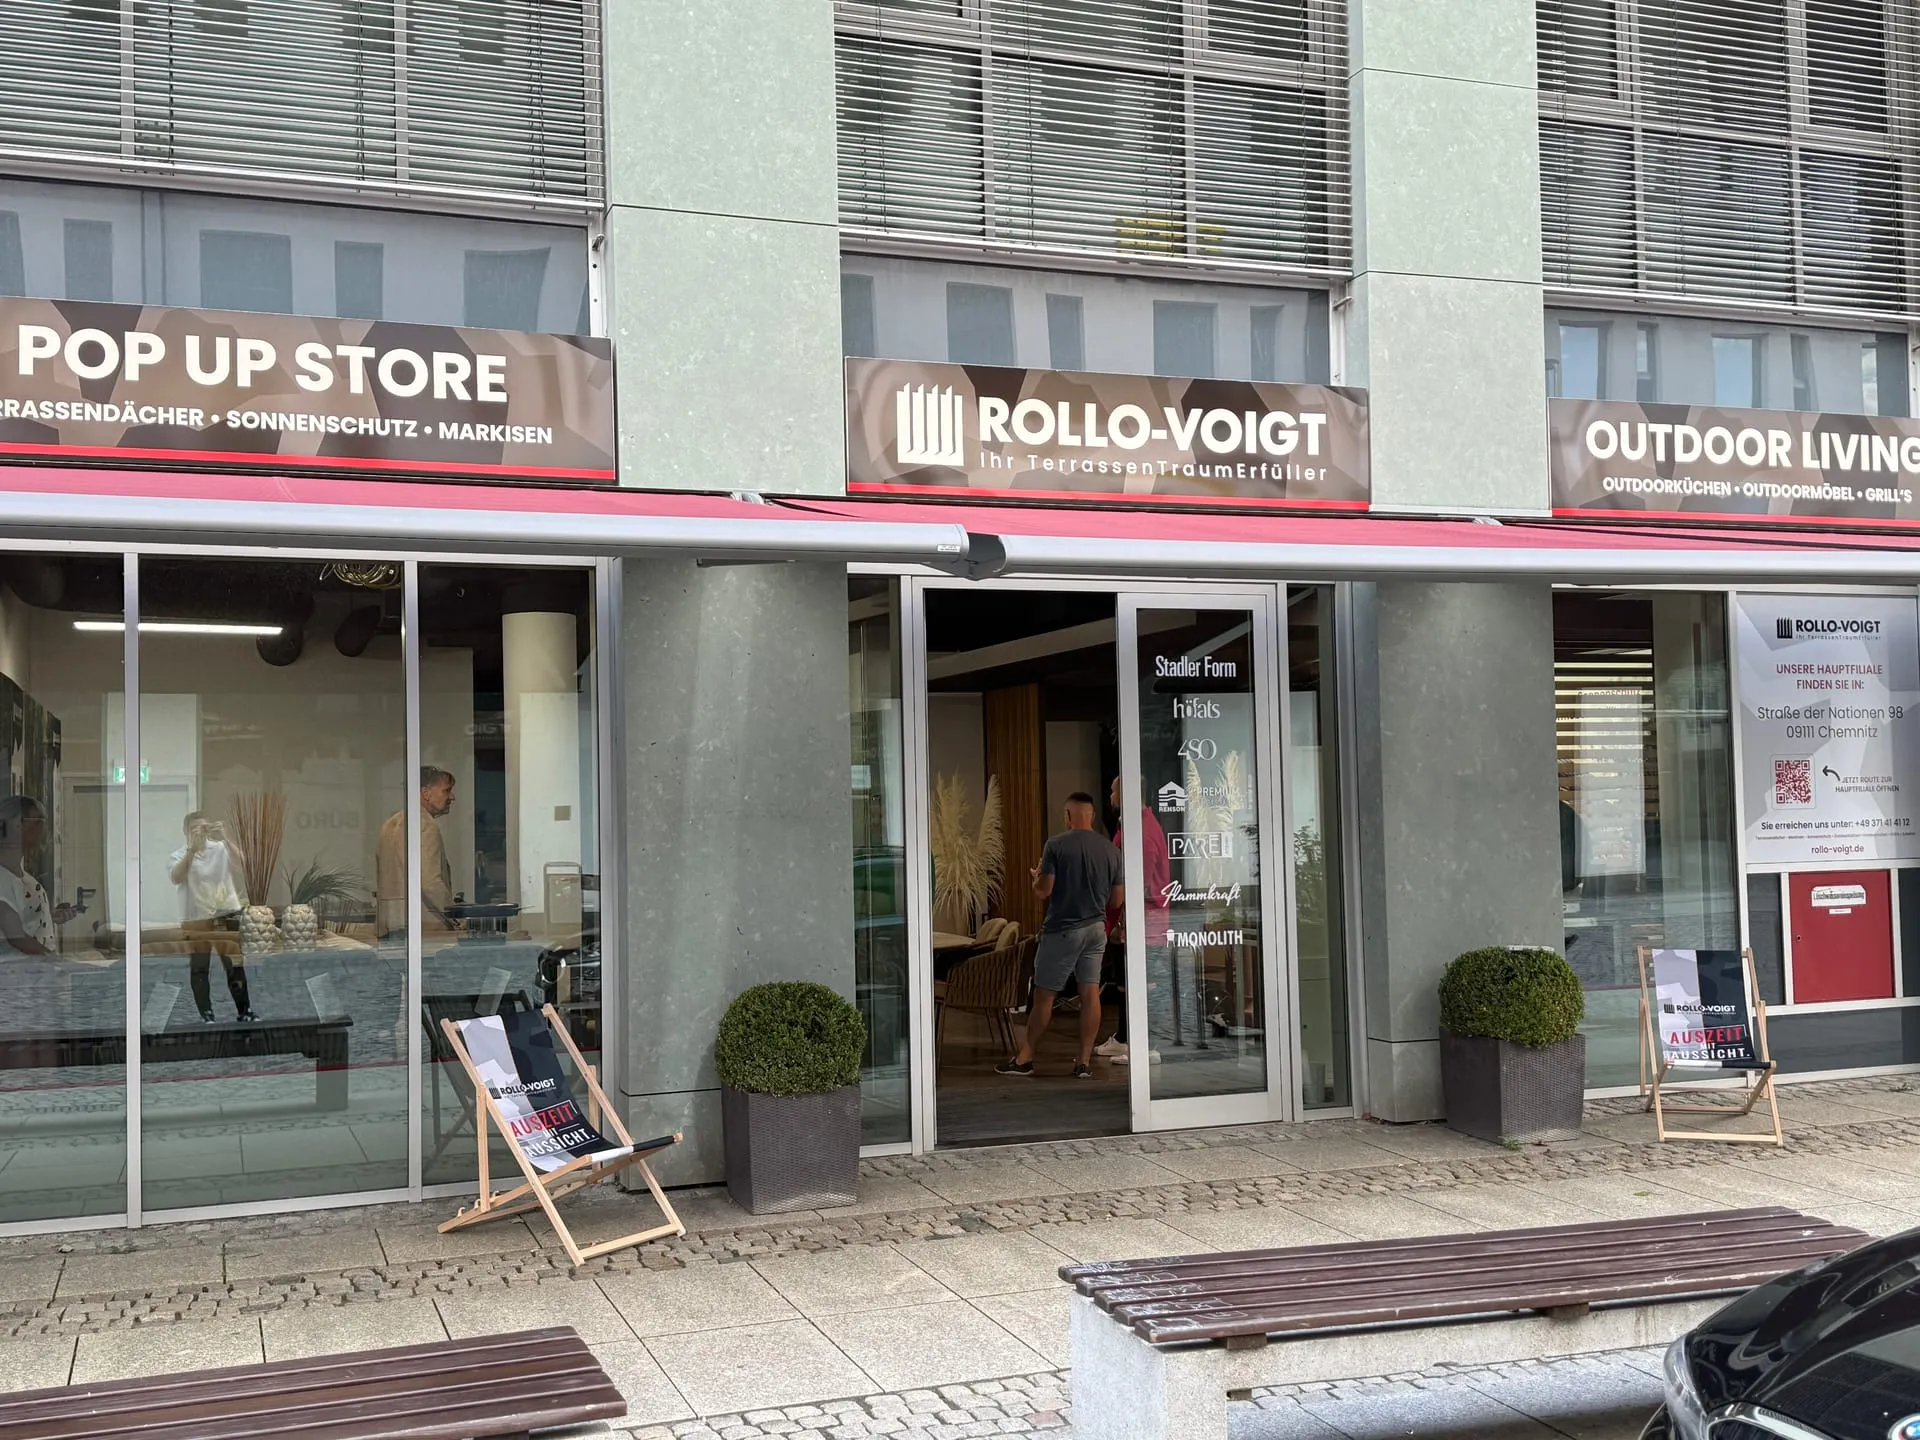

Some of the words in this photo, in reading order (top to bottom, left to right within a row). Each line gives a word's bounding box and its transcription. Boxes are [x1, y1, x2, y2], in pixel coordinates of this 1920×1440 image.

[18, 324, 166, 381] POP
[185, 334, 277, 388] UP
[294, 343, 508, 402] STORE
[0, 398, 204, 427] RASSENDÄCHER
[226, 409, 418, 438] SONNENSCHUTZ
[439, 421, 553, 445] MARKISEN
[979, 396, 1327, 456] ROLLO-VOIGT
[1585, 420, 1792, 468] OUTDOOR
[1802, 432, 1920, 473] LIVING
[980, 452, 1014, 469] Ihr
[1027, 454, 1327, 481] TerrassenTraumErfüller
[1603, 476, 1731, 497] OUTDOORKÜCHEN
[1743, 482, 1855, 502] OUTDOORMÖBEL
[1796, 619, 1880, 633] ROLLO-VOIGT
[1155, 655, 1201, 677] Stadler
[1204, 656, 1237, 677] Form
[1776, 664, 1815, 674] UNSERE
[1817, 664, 1884, 675] HAUPTFILIALE
[1796, 680, 1832, 690] FINDEN
[1835, 680, 1849, 690] SIE
[1851, 680, 1864, 690] IN:
[1757, 706, 1800, 720] Straße
[1804, 706, 1825, 719] der
[1828, 706, 1885, 719] Nationen
[1888, 706, 1904, 719] 98
[1786, 725, 1815, 738] 09111
[1818, 725, 1878, 738] Chemnitz
[1177, 738, 1217, 760] 4SO
[1761, 822, 1774, 830] Sie
[1775, 821, 1813, 830] erreichen
[1814, 821, 1829, 829] uns
[1830, 820, 1853, 829] unter:
[1855, 819, 1870, 828] +49
[1871, 818, 1883, 827] 371
[1884, 818, 1892, 827] 41
[1902, 818, 1910, 826] 12
[1811, 845, 1864, 855] rollo-voigt.de
[1160, 880, 1241, 908] Flammkraft
[1177, 929, 1243, 948] MONOLITH
[1670, 1026, 1742, 1044] AUSZEIT
[1671, 1048, 1750, 1059] AUSSICHT.
[500, 1078, 555, 1095] ROLLO-VOIGT
[510, 1103, 574, 1137] AUSZEIT
[525, 1128, 595, 1158] AUSSICHT.
